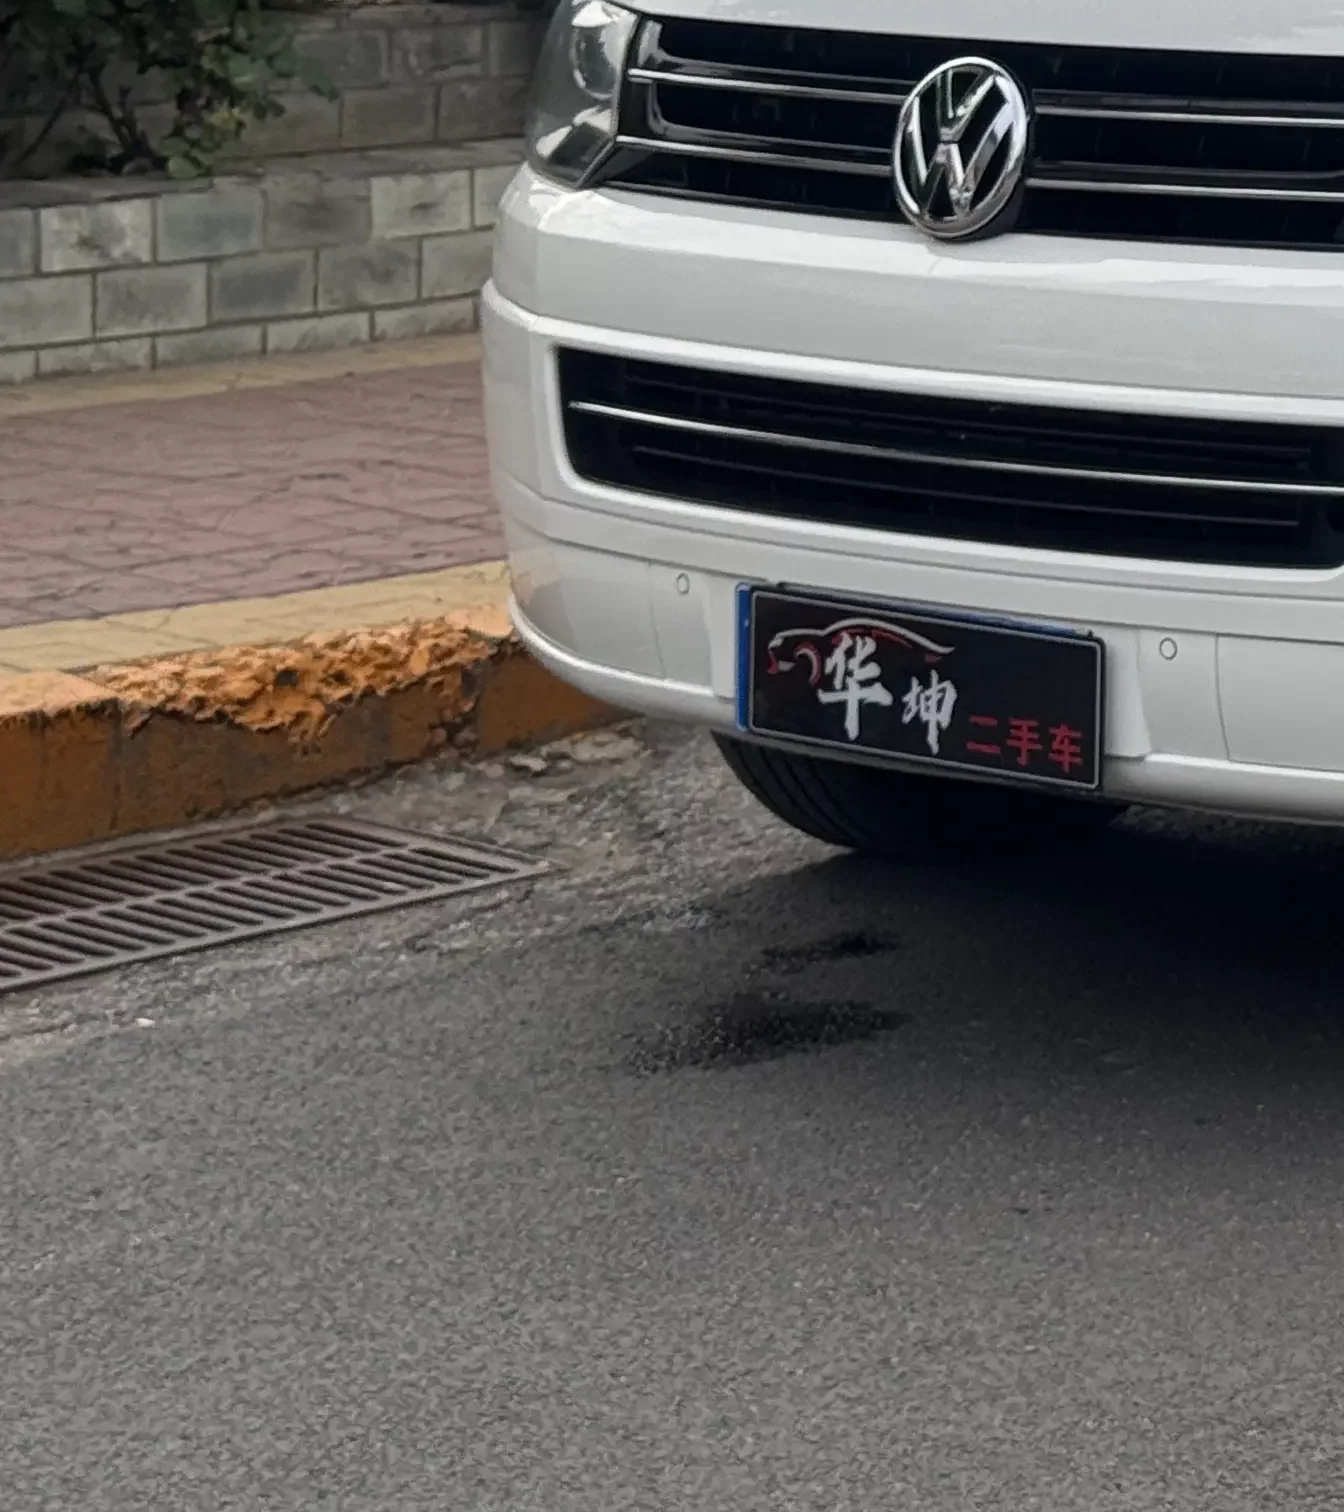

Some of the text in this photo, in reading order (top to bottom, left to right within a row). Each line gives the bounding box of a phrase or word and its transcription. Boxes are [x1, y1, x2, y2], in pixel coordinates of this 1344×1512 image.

[817, 630, 959, 755] 华坤
[965, 714, 1084, 774] 二手车
